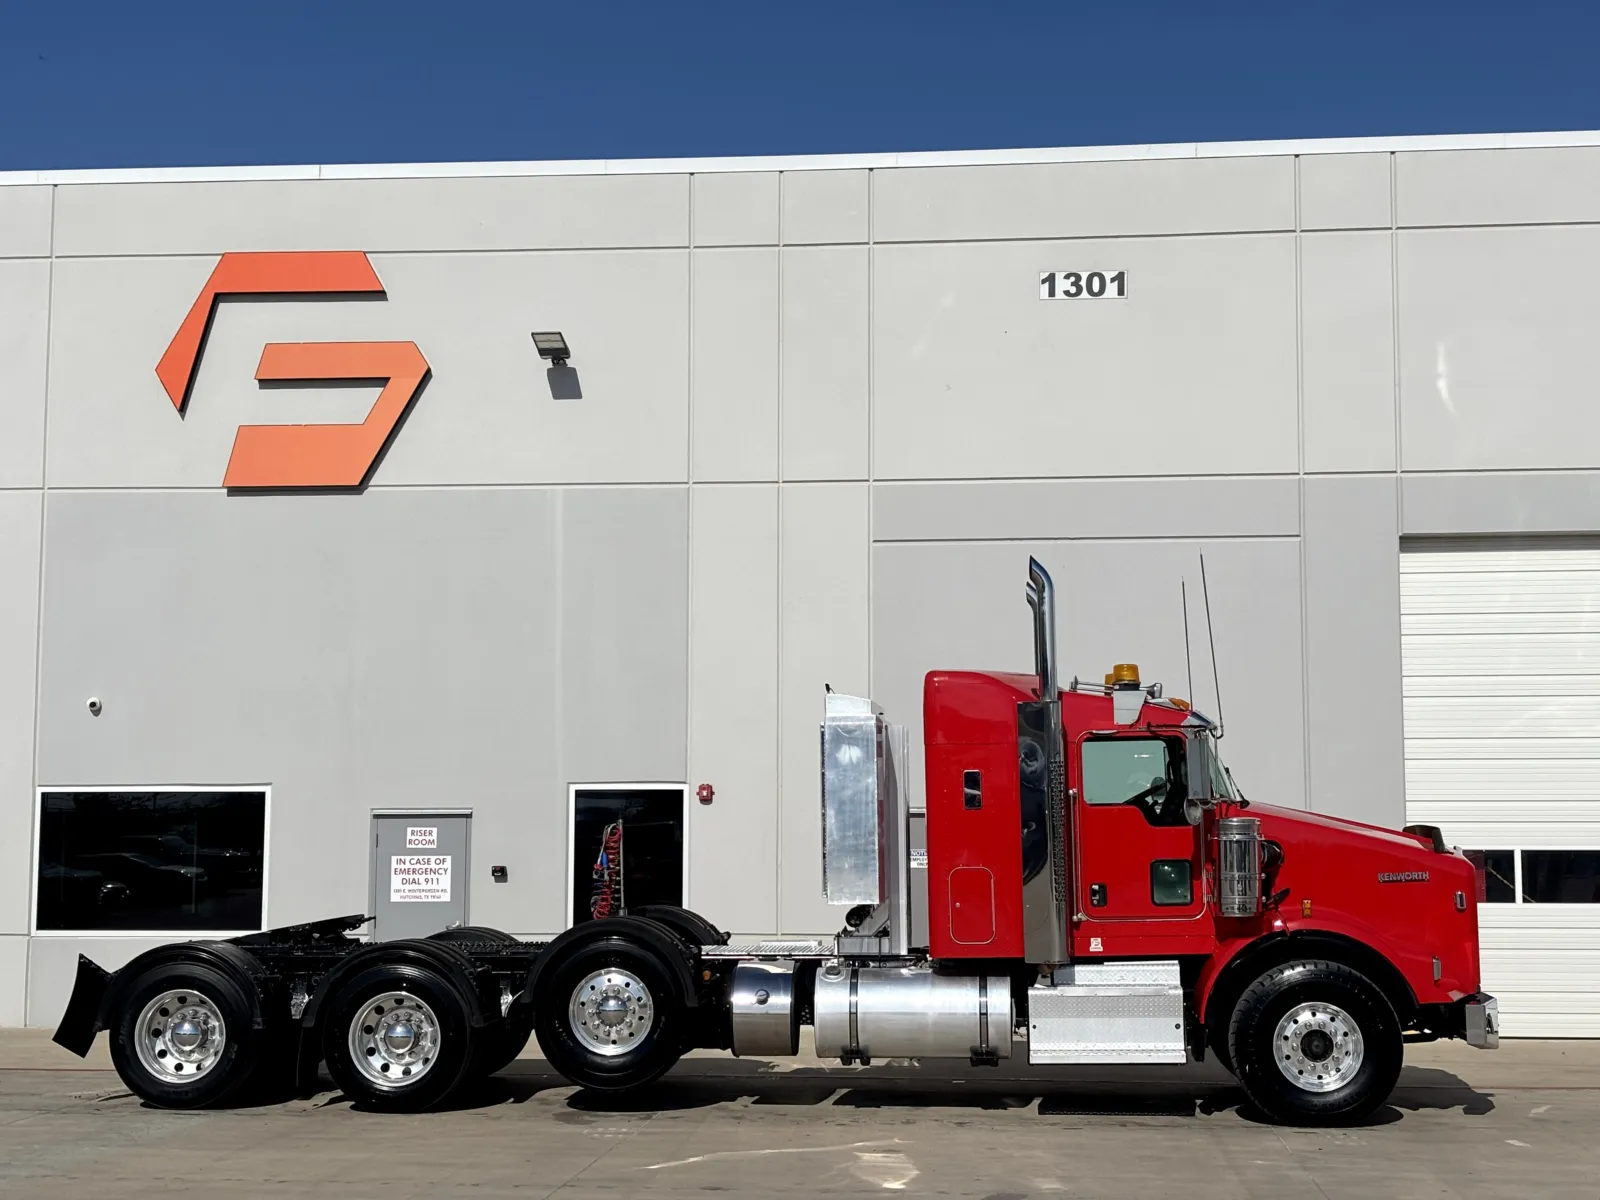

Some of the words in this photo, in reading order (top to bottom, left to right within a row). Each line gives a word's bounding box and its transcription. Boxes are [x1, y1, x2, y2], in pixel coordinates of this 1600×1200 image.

[1041, 271, 1125, 298] 1301
[434, 858, 447, 866] OF
[1378, 871, 1429, 882] KENWORTH
